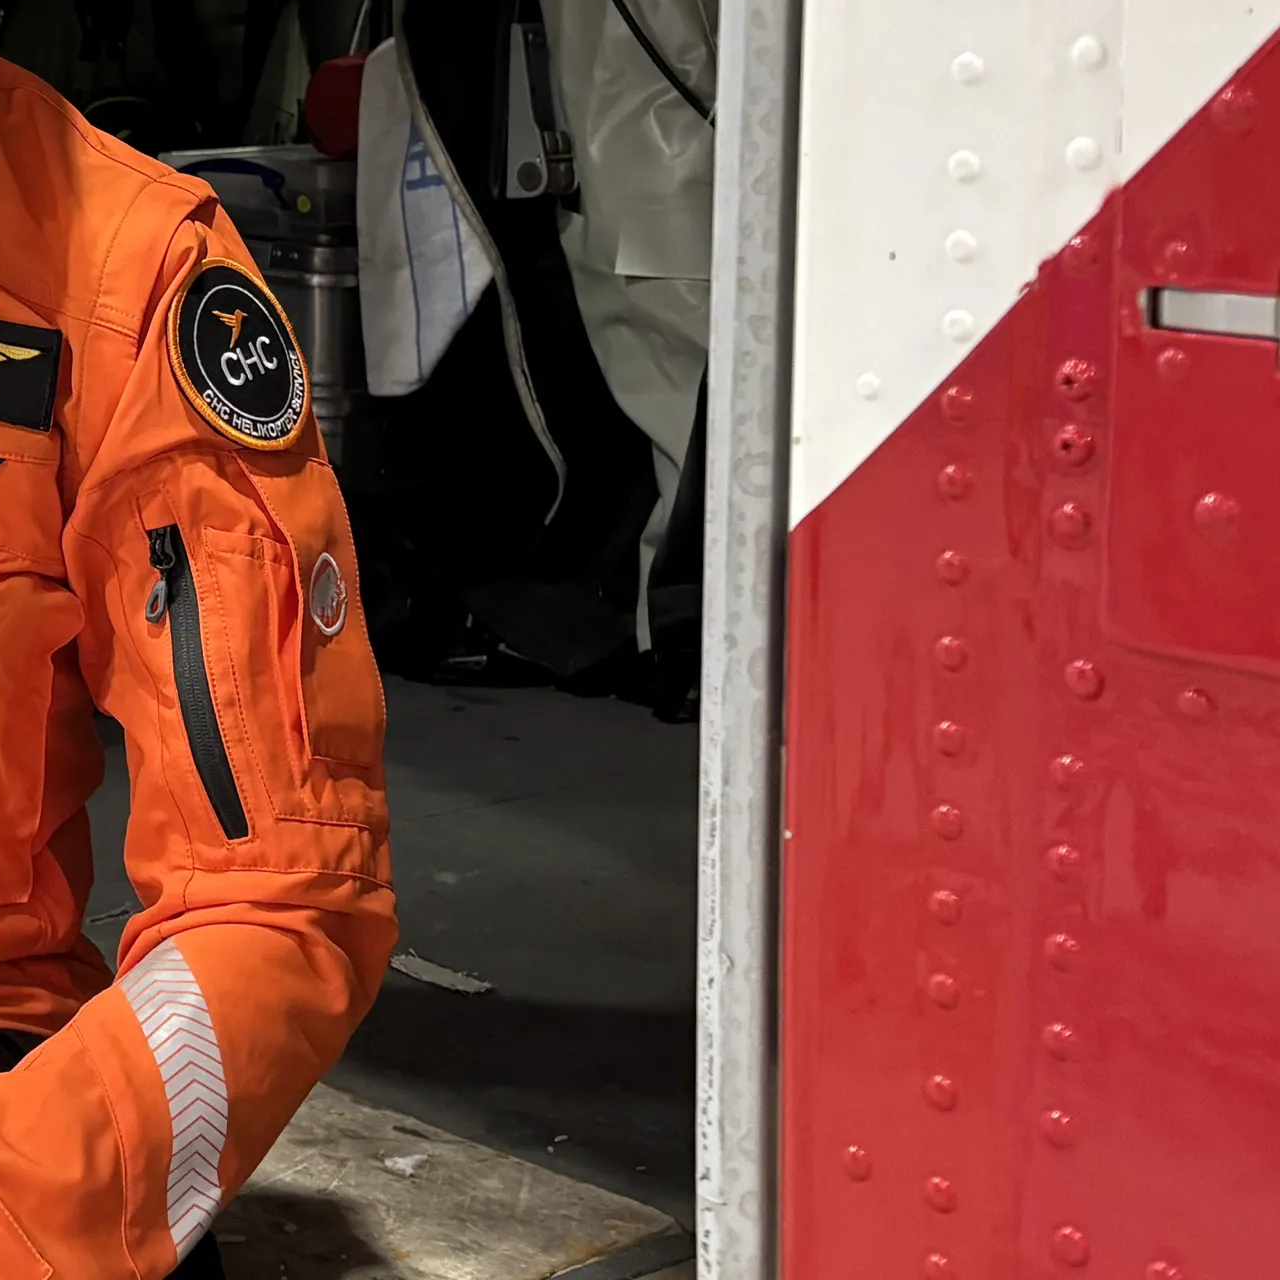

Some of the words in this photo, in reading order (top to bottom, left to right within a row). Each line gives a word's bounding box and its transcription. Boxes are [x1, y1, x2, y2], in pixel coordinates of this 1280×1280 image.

[202, 389, 230, 421] CHC
[232, 408, 298, 438] HELIKOPTER
[288, 349, 304, 413] SERVICE
[220, 335, 278, 387] CHC
